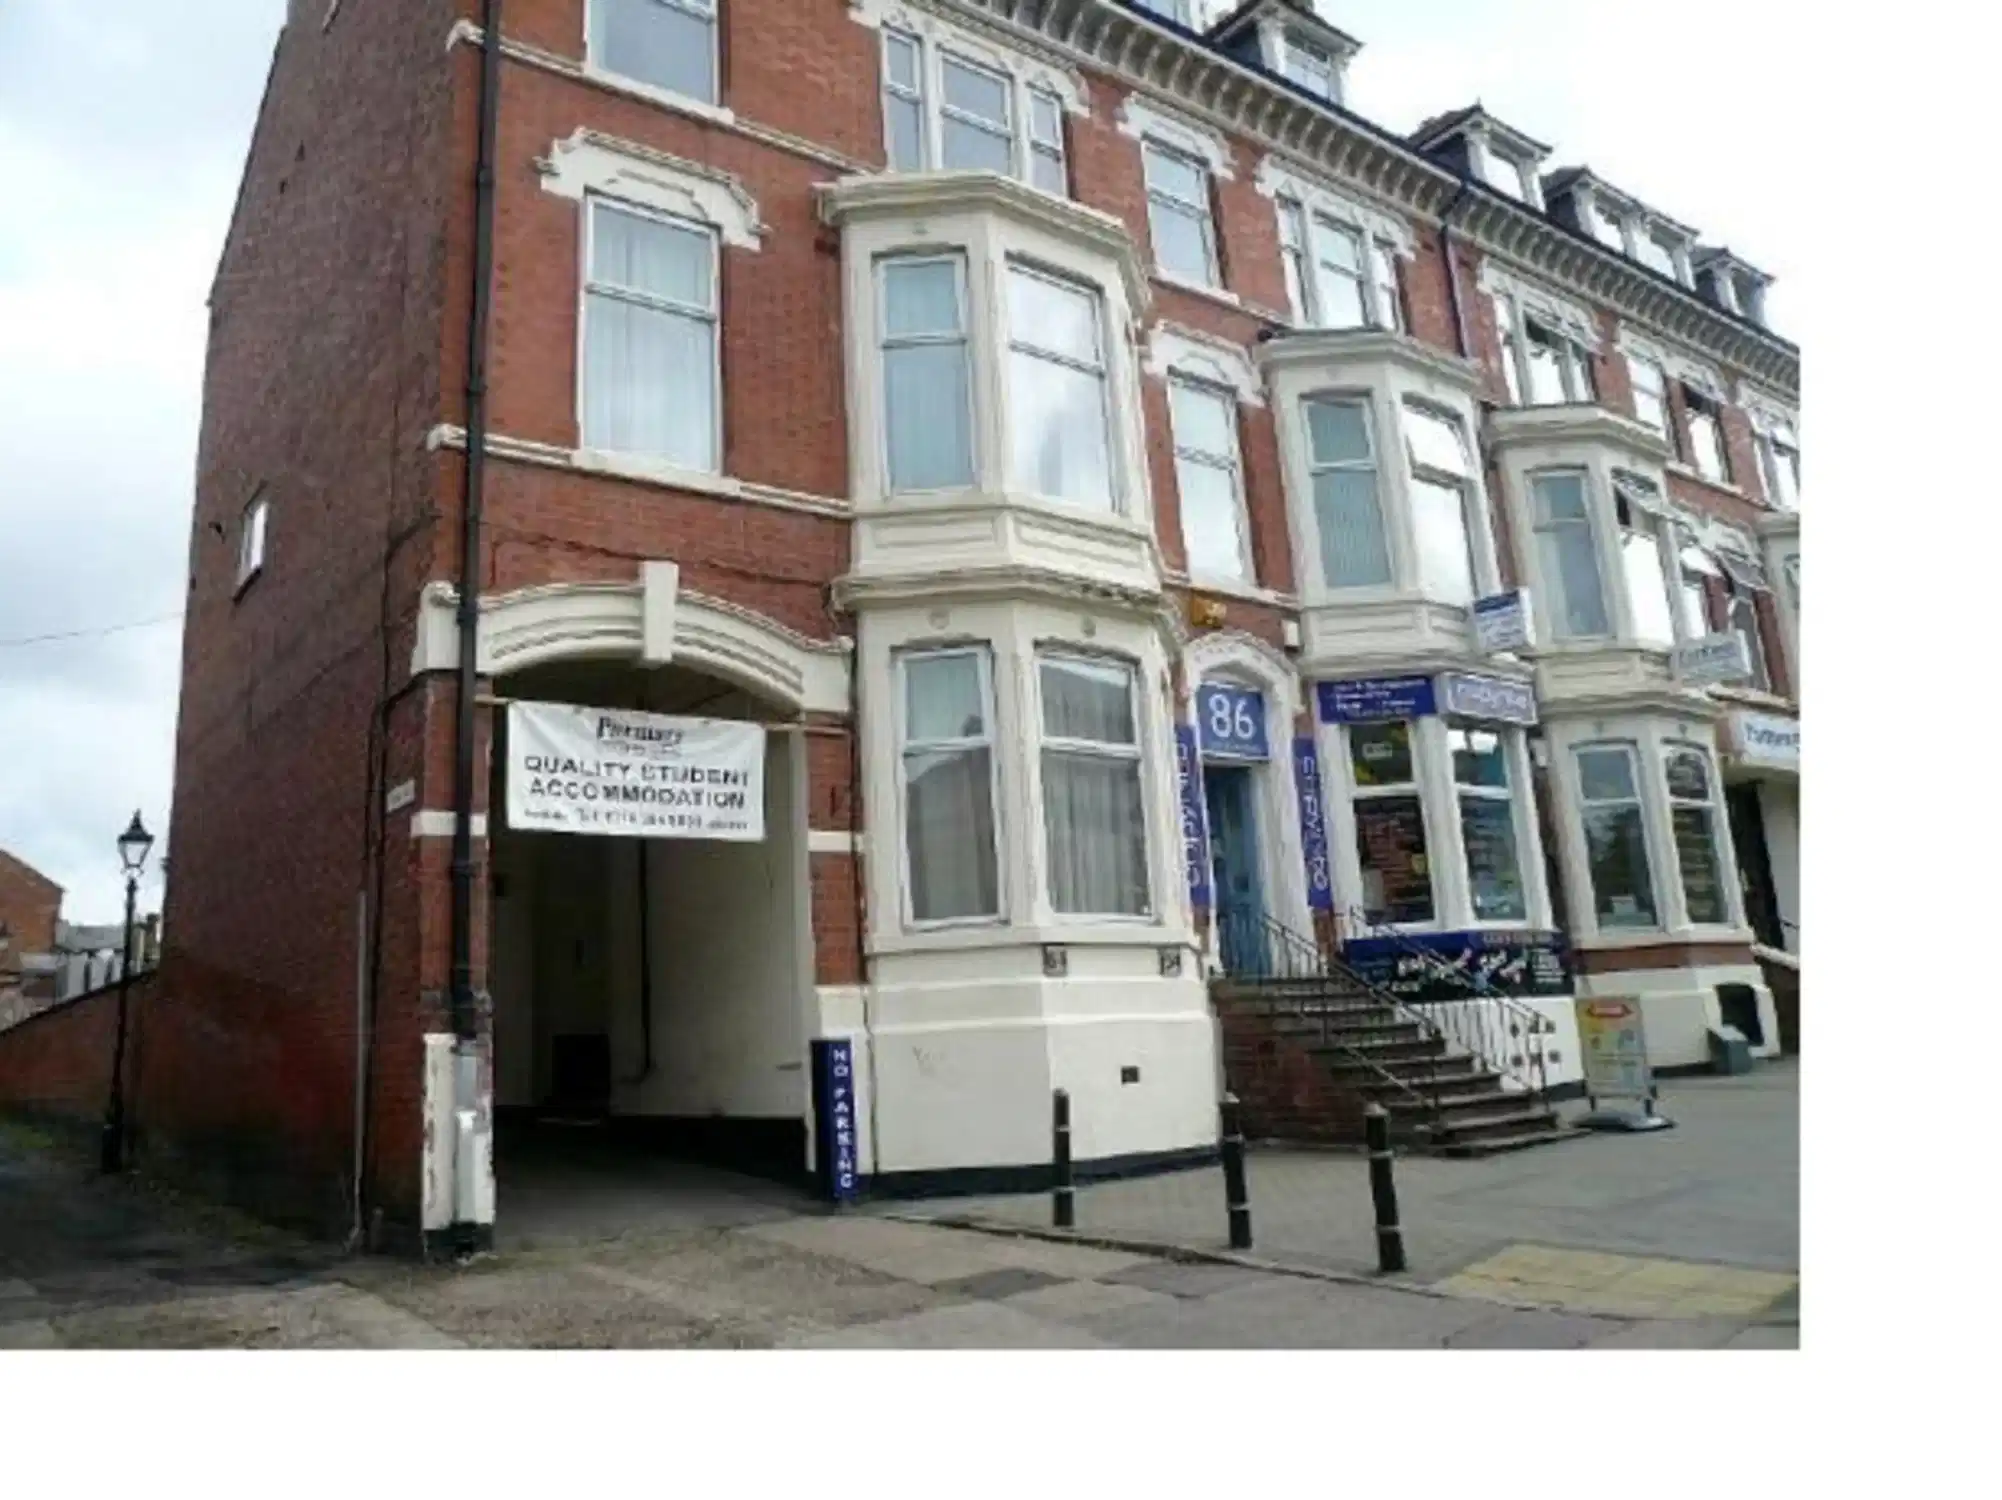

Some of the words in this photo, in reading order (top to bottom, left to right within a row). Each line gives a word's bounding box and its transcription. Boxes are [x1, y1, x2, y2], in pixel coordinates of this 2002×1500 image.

[1207, 693, 1255, 739] 86
[523, 755, 632, 781] QUALITY
[641, 762, 748, 787] STUDENT
[529, 775, 745, 810] ACCOMMODATION
[832, 1049, 849, 1077] NO
[834, 1086, 852, 1189] PARKING
